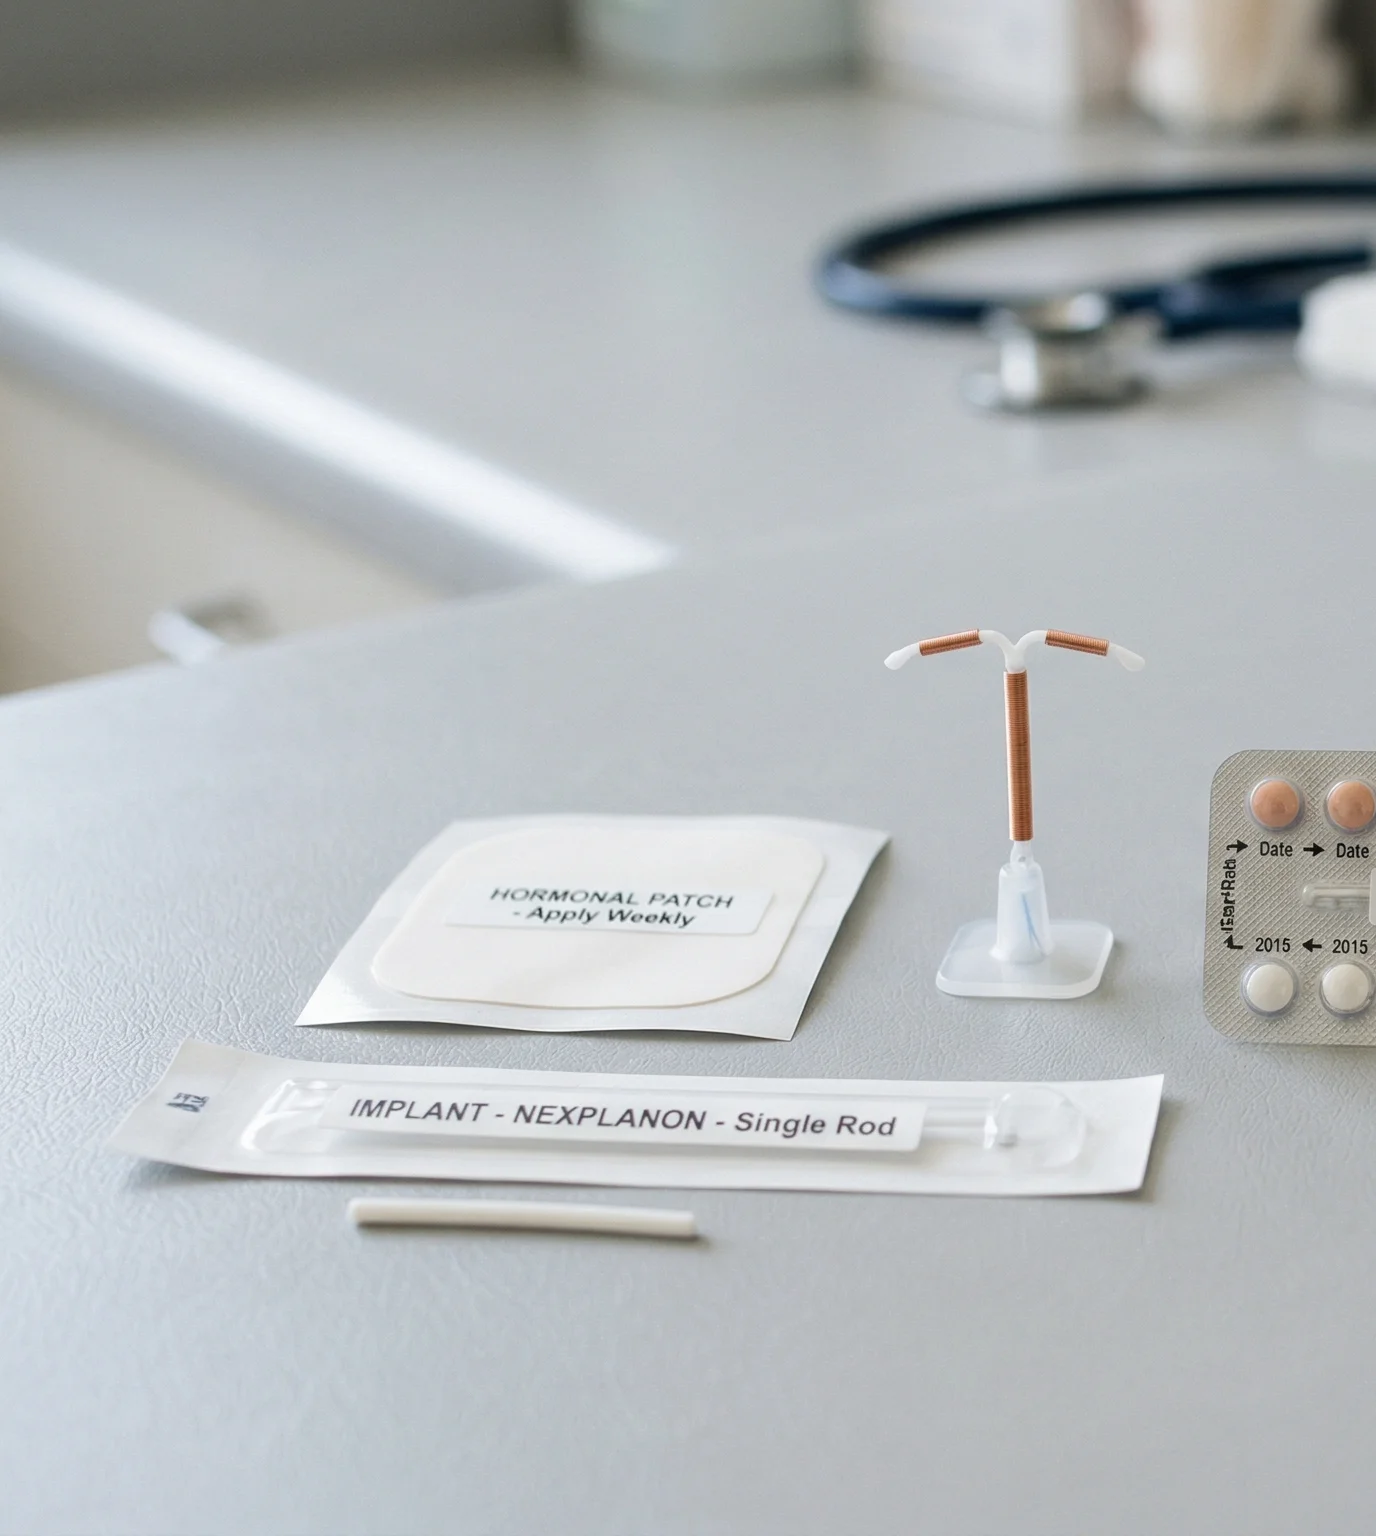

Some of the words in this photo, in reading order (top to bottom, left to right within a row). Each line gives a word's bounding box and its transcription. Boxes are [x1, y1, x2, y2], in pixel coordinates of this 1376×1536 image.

[1259, 840, 1294, 858] Date
[1336, 842, 1370, 859] Date
[490, 888, 638, 906] HORMONAL
[648, 893, 733, 908] PATCH
[526, 905, 599, 924] Apply
[608, 908, 696, 928] Weekly
[1255, 937, 1291, 953] 2015
[1332, 938, 1368, 955] 2015
[350, 1099, 489, 1122] IMPLANT
[513, 1104, 707, 1131] NEXPLANON
[734, 1112, 826, 1139] Single
[836, 1115, 896, 1136] Rod
